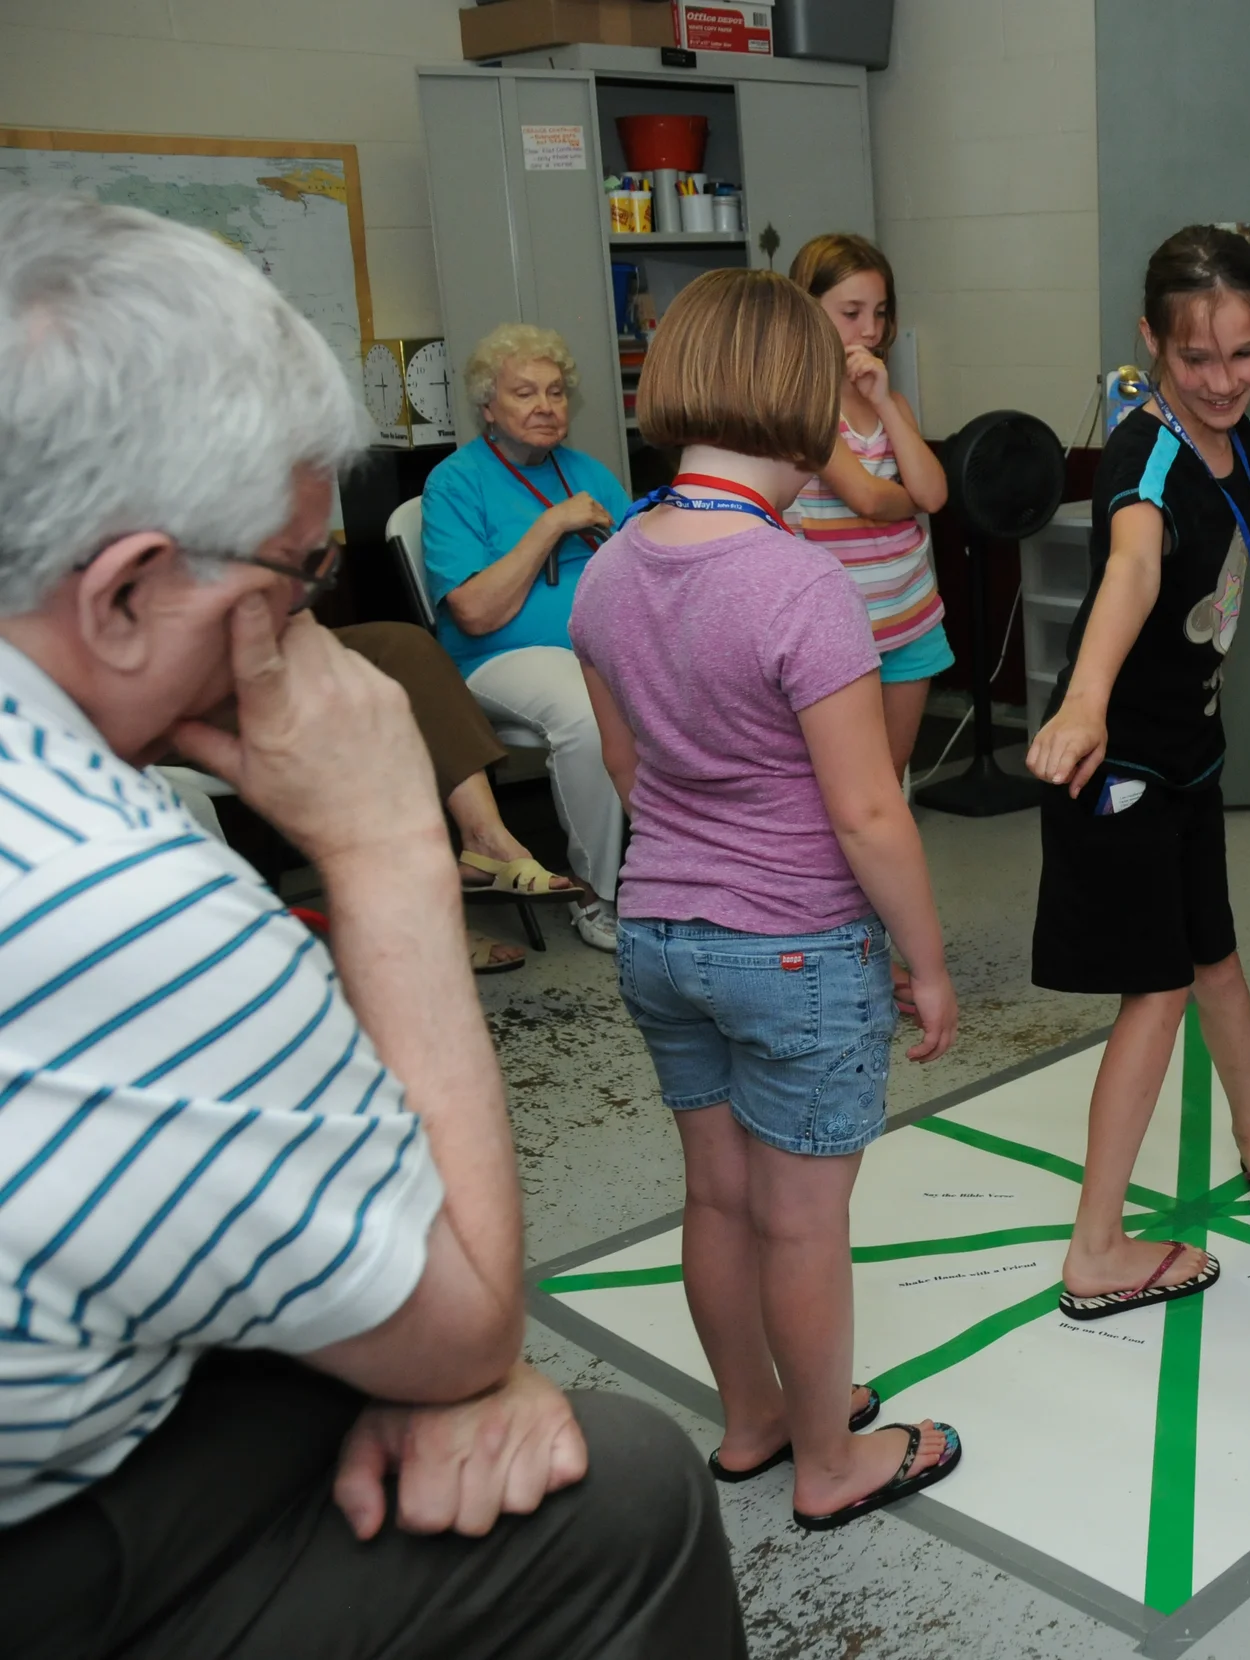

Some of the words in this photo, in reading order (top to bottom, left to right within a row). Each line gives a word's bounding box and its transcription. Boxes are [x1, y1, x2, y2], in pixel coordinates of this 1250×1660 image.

[687, 12, 717, 23] Office
[717, 17, 743, 25] DEPOT
[692, 500, 714, 510] Way!
[899, 1278, 931, 1287] Shake
[934, 1273, 966, 1281] Hands
[1002, 1261, 1037, 1271] Friend
[1059, 1322, 1079, 1332] Hop
[1098, 1330, 1119, 1339] One
[1122, 1335, 1145, 1345] Foot
